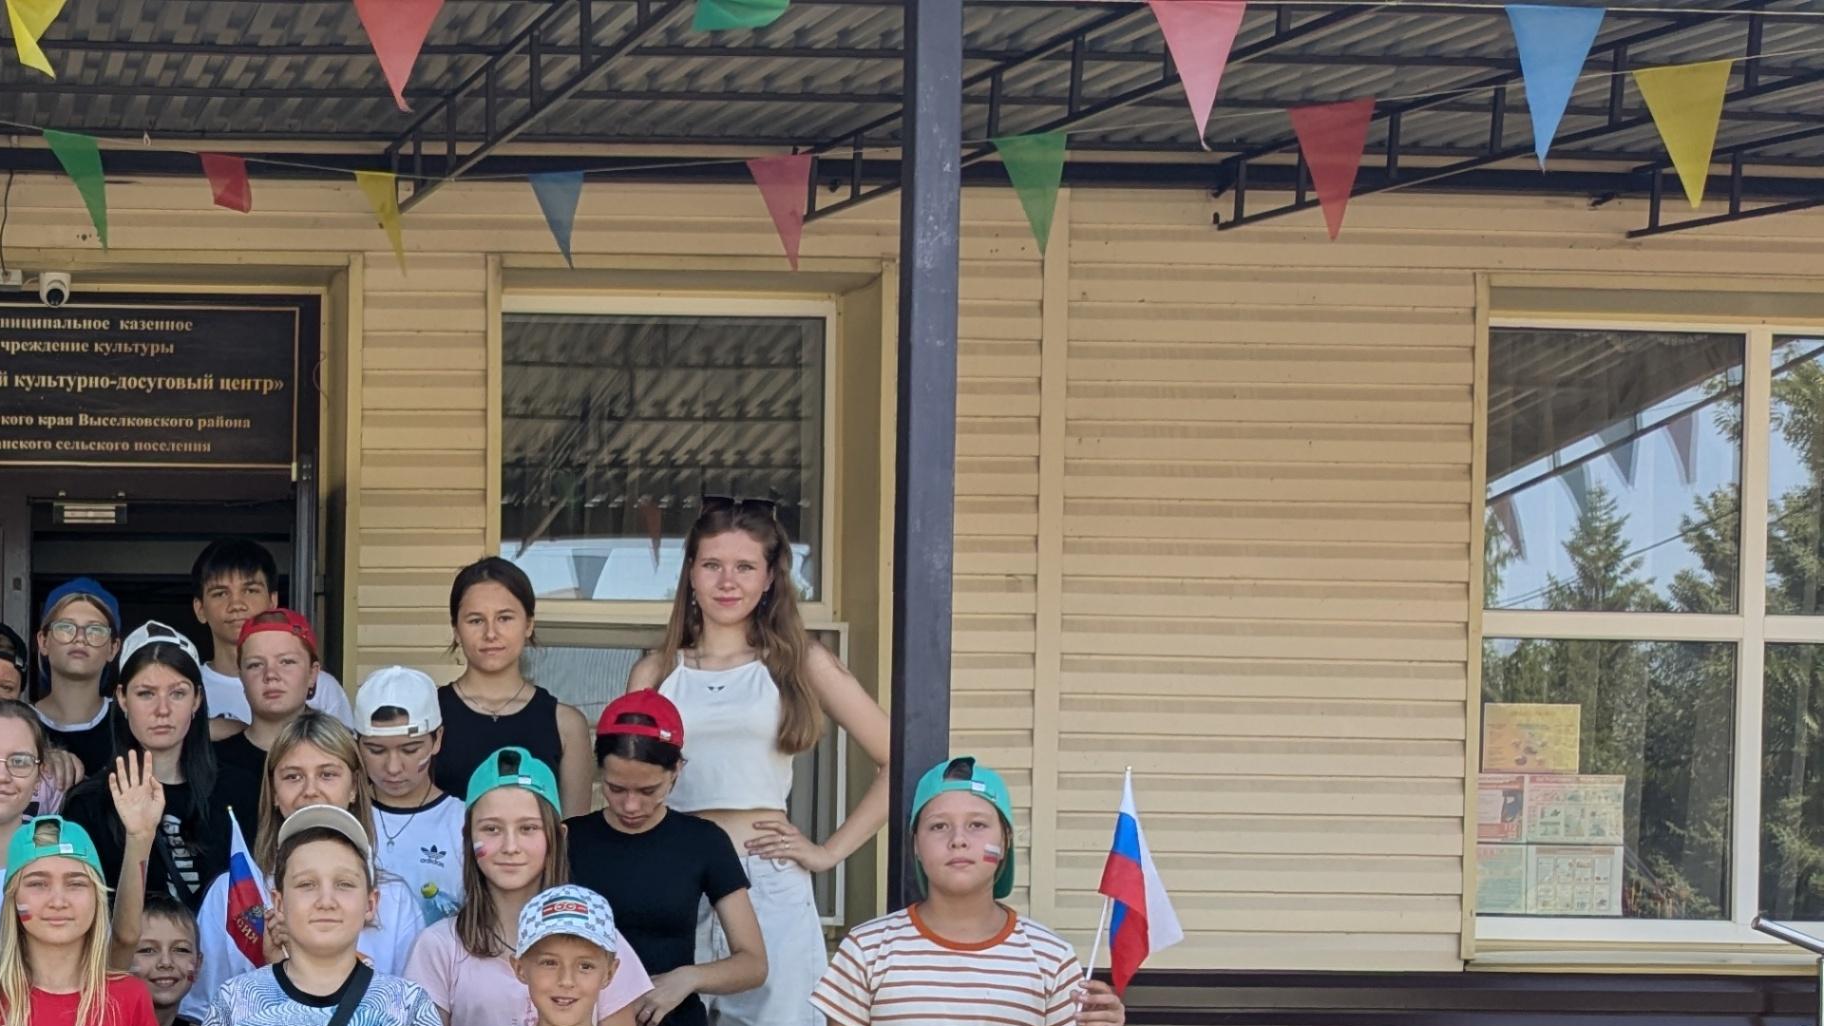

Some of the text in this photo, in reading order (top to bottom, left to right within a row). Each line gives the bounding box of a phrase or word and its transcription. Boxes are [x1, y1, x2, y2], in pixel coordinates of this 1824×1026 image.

[119, 319, 193, 332] казенное
[94, 342, 175, 357] культуры
[14, 373, 214, 394] культурно-досуговый
[219, 377, 285, 396] центр»
[38, 415, 74, 429] края
[78, 413, 194, 428] Выселковского
[197, 415, 251, 431] района
[55, 439, 130, 451] сельского
[134, 441, 212, 453] поселения
